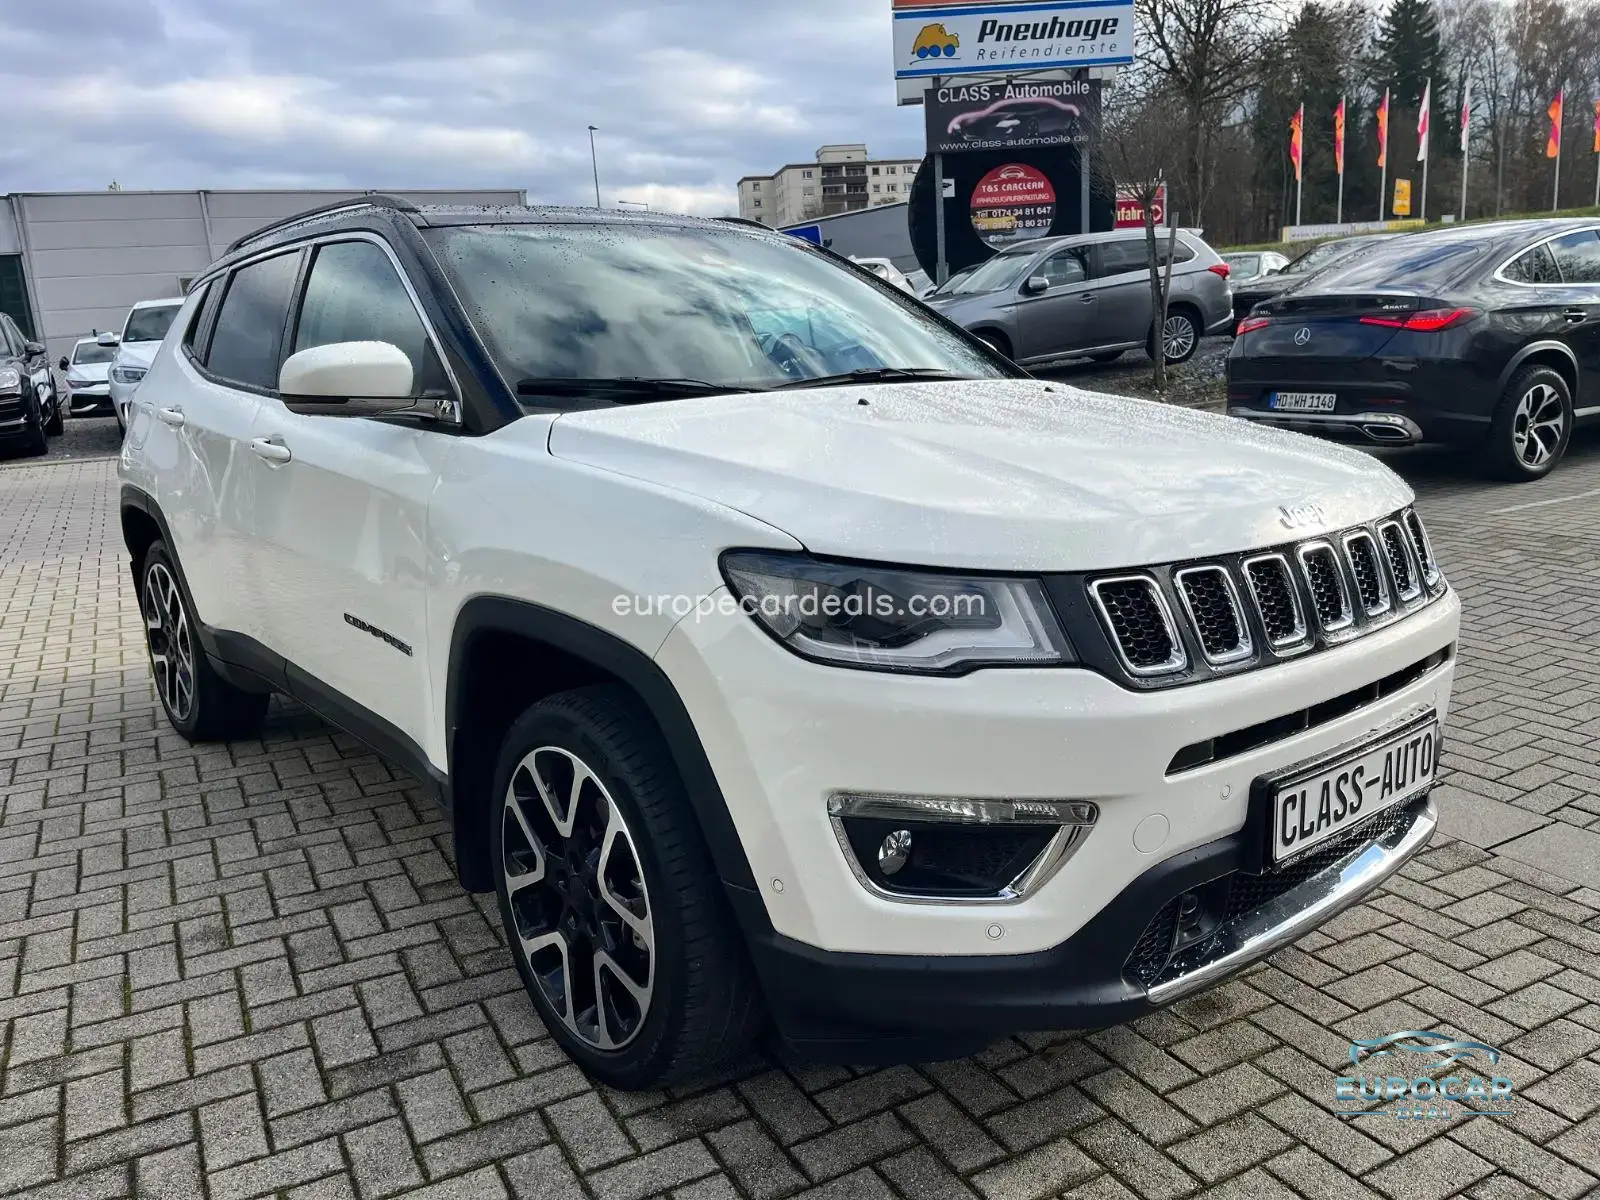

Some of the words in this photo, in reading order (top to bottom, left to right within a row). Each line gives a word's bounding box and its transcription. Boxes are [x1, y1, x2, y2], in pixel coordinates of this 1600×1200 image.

[977, 16, 1119, 43] Pneuhage
[976, 42, 1118, 60] Reifendienste
[937, 86, 991, 103] CLASS
[1004, 80, 1090, 99] Automobile
[939, 134, 1089, 150] www.class-automobilede
[981, 184, 999, 193] T&S
[1001, 181, 1044, 191] CARCLEAN
[991, 209, 1012, 217] 0174
[1012, 208, 1023, 216] 34
[1025, 207, 1035, 215] 81
[1036, 206, 1052, 214] 647
[1025, 219, 1036, 227] 80
[1036, 218, 1052, 227] 217
[1307, 395, 1335, 409] 1148
[1281, 732, 1433, 847] CLASS-AUTO
